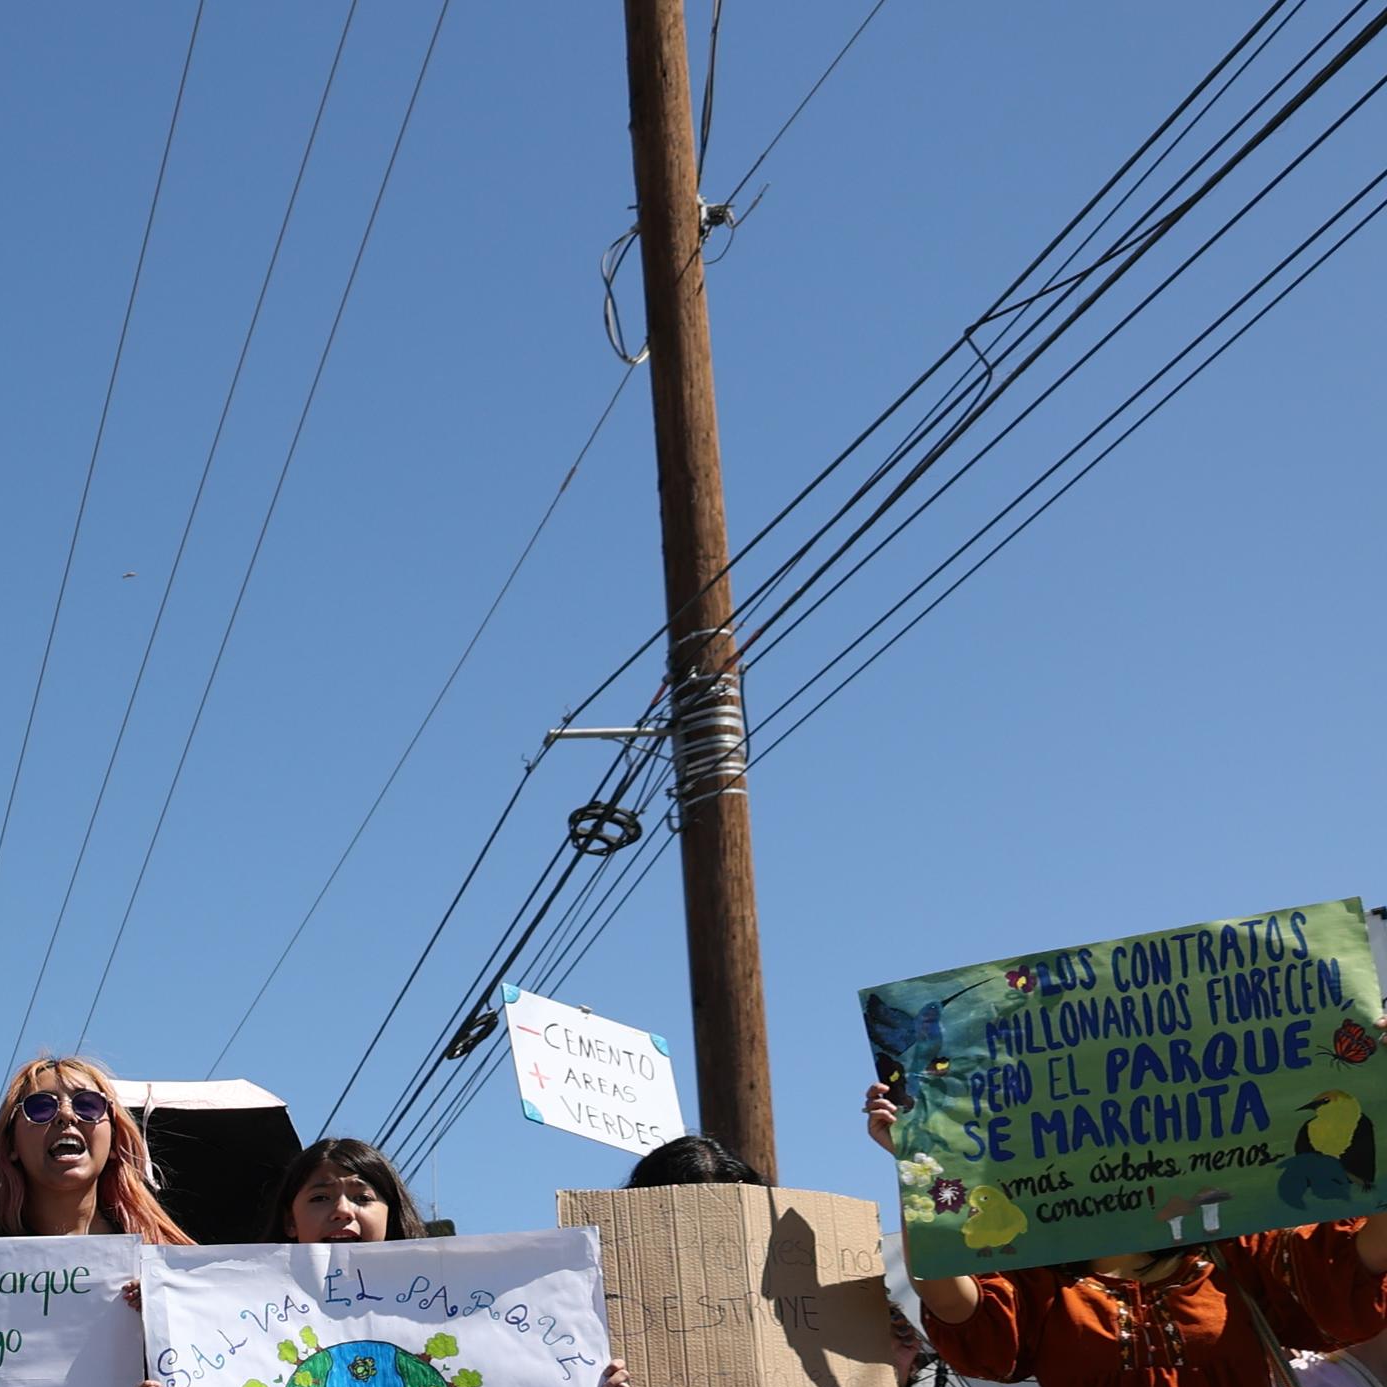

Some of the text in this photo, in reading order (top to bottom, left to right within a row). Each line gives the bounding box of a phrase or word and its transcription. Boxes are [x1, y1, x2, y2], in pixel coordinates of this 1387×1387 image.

[1036, 911, 1308, 996] LOS CONTRATOS
[985, 957, 1355, 1060] MILLONARIOS FLORECEN,
[543, 1022, 655, 1081] CEMENTO
[564, 1067, 637, 1104] AREAS
[970, 1019, 1312, 1118] PERO EL PARQUE
[559, 1095, 667, 1146] VERDES
[963, 1080, 1270, 1162] SE MARCHITA
[324, 1268, 384, 1308] EL
[396, 1275, 596, 1381] PARQUE
